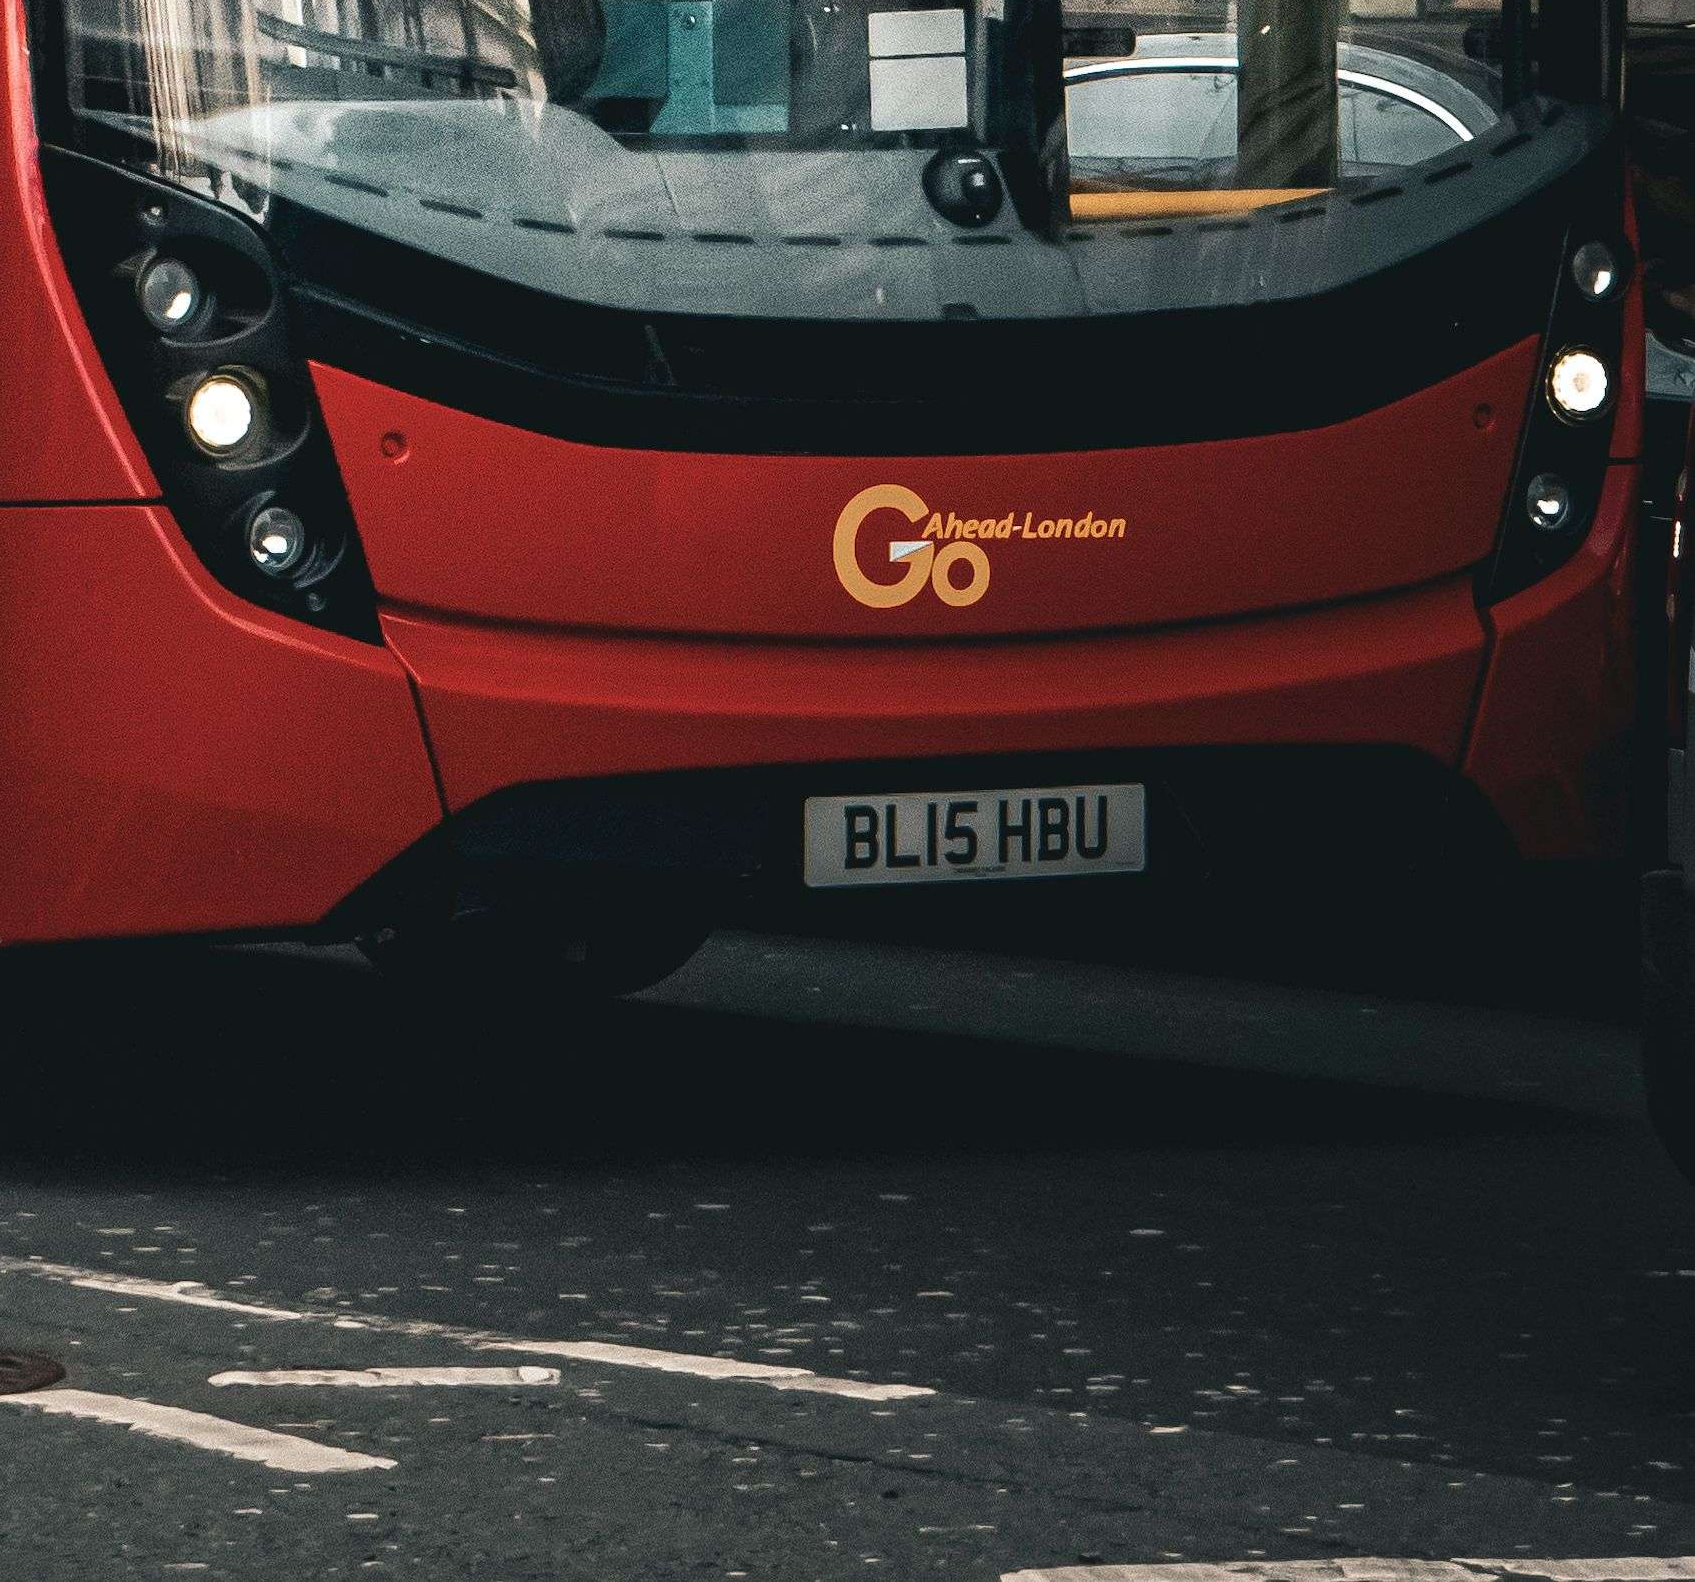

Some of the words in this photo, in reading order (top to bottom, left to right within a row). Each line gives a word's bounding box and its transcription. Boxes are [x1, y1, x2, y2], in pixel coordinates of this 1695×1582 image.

[833, 483, 991, 608] Go
[922, 509, 1126, 542] Ahead-London
[844, 800, 978, 869] BL15
[998, 795, 1108, 863] HBU
